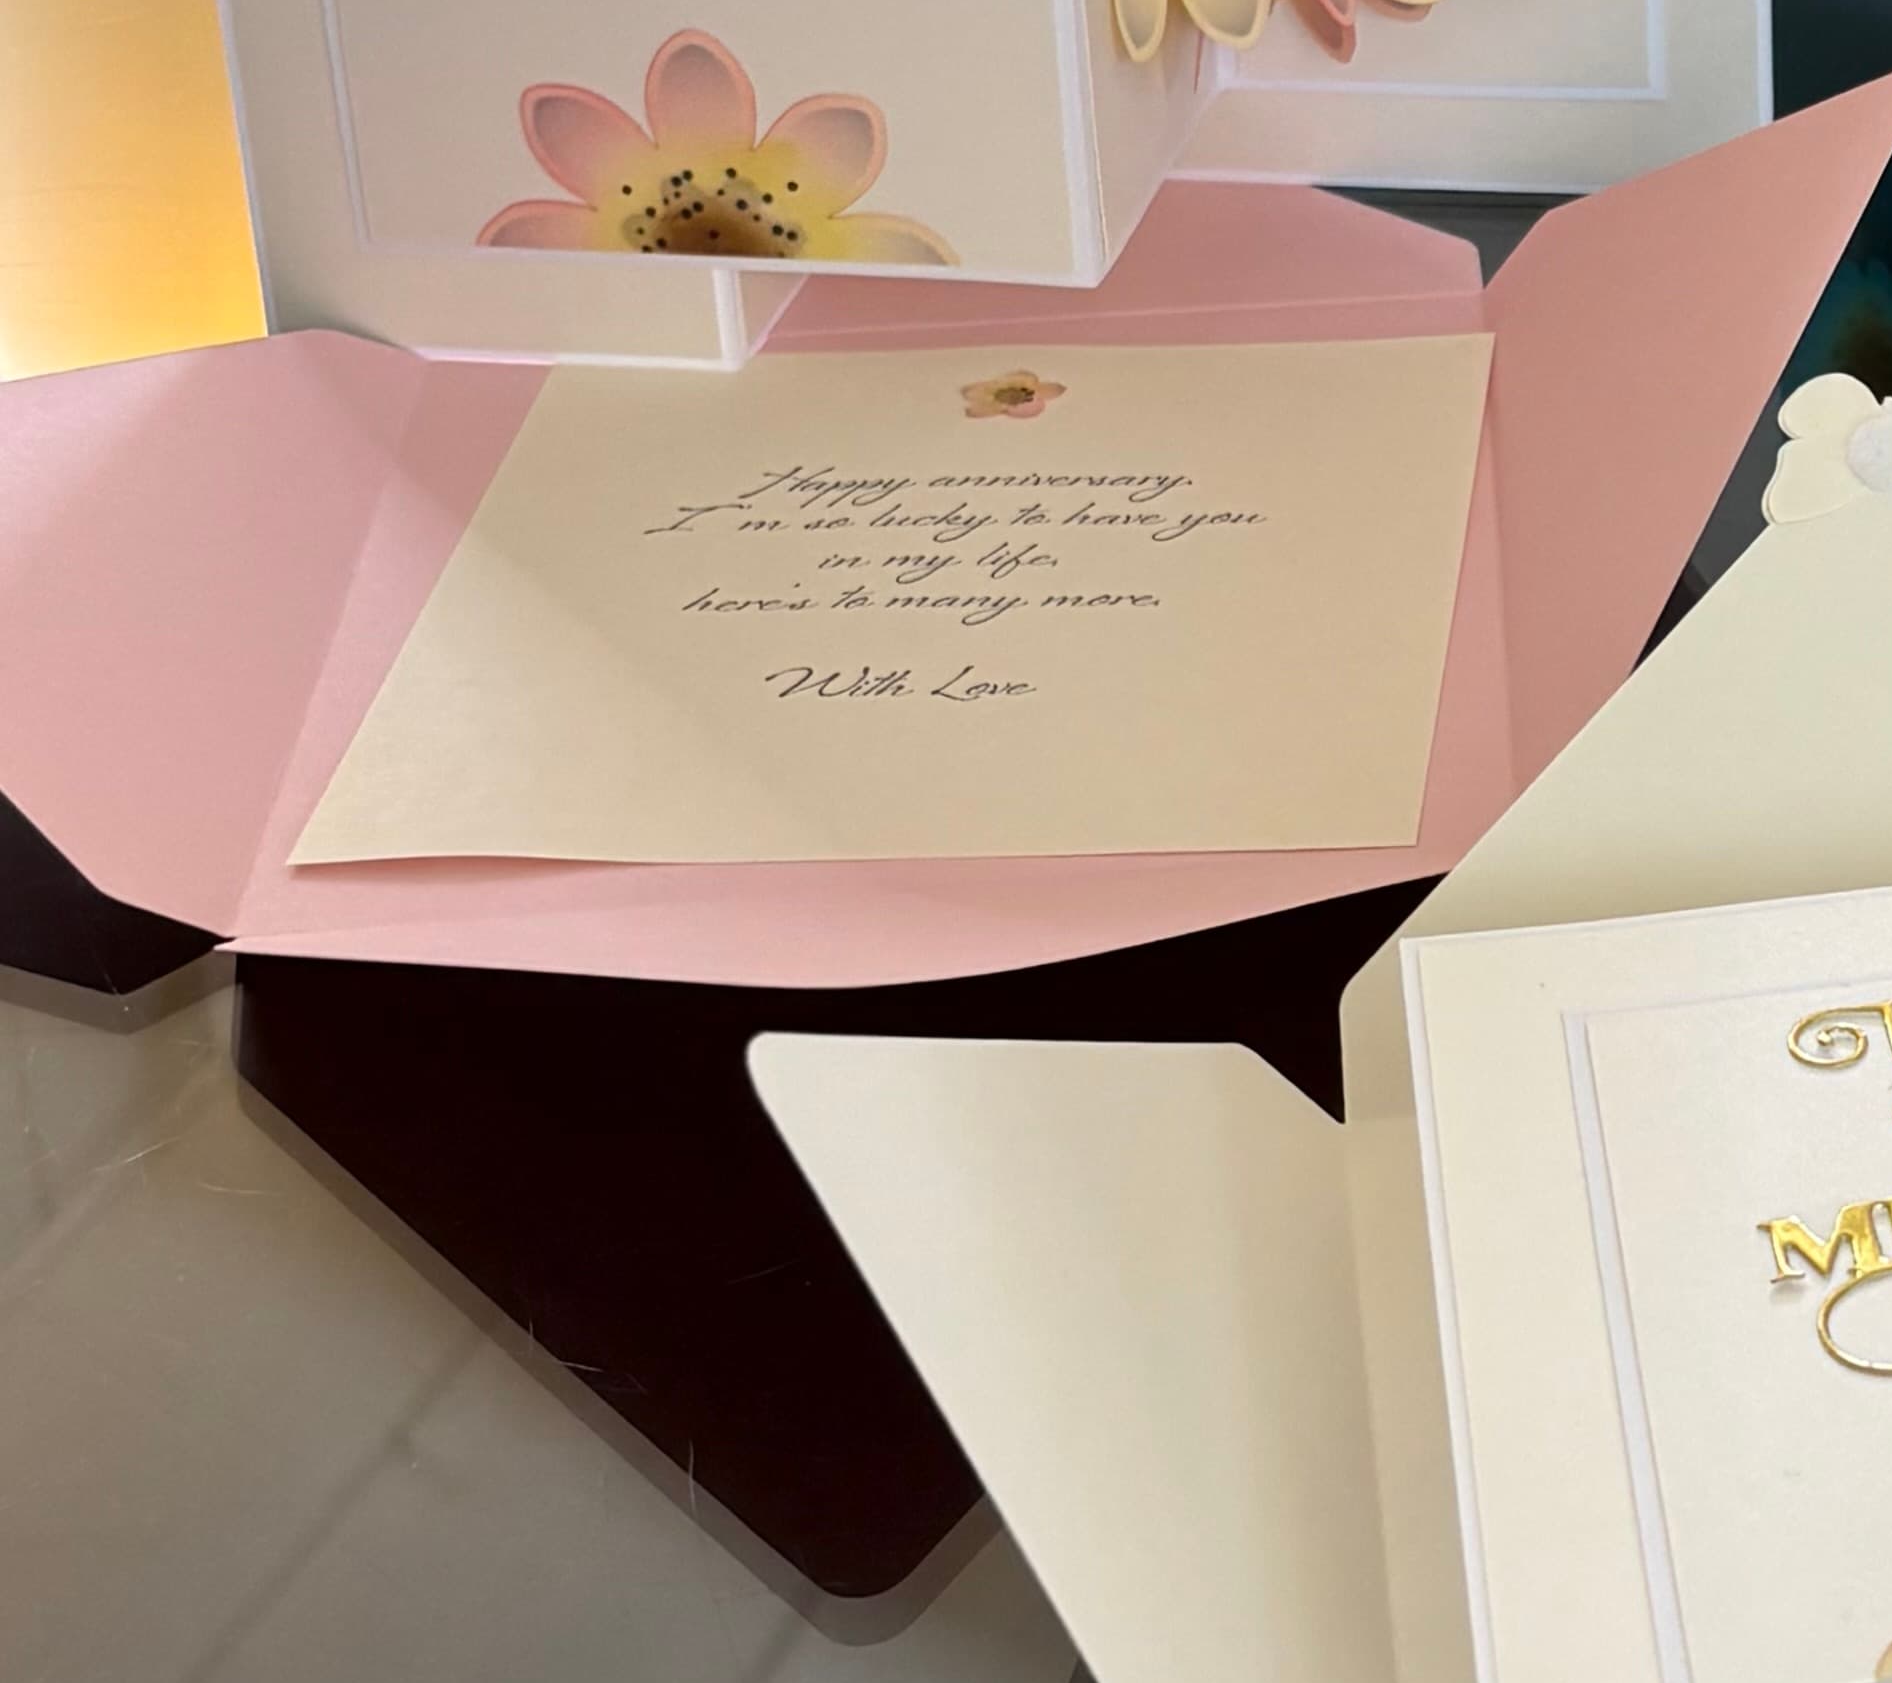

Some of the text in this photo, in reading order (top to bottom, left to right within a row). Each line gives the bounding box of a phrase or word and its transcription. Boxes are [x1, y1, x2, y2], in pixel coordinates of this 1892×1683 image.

[738, 466, 916, 508] Happy
[643, 502, 1267, 543] I'm so lucky to have you
[818, 554, 871, 569] in
[881, 554, 962, 585] my
[681, 583, 820, 612] here's
[830, 585, 875, 610] to
[885, 595, 1028, 626] many
[764, 665, 1037, 702] With Love
